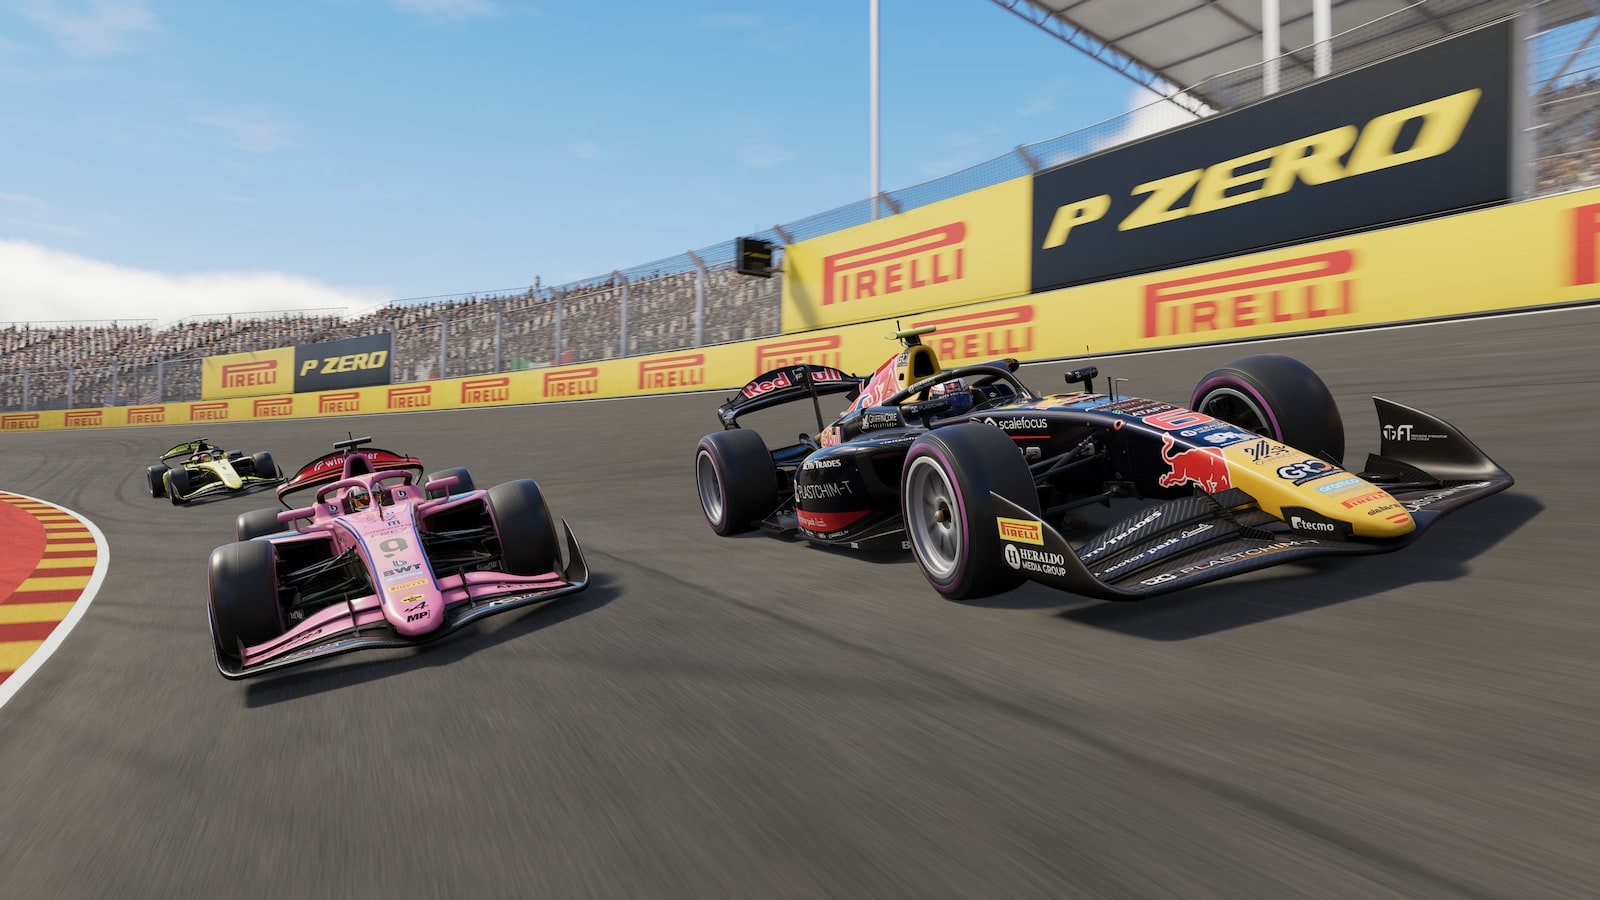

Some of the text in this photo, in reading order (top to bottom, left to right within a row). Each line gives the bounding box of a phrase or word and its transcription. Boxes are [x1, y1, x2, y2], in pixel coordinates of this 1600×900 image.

[1042, 88, 1483, 250] P ZERO
[823, 220, 967, 306] PIRELLI
[1142, 249, 1358, 338] PIRELLI
[222, 359, 278, 388] PIRELLI
[299, 350, 389, 377] P ZERO
[638, 353, 705, 390] PIRELLI
[460, 377, 510, 404] PIRELLI
[543, 367, 599, 398] PIRELLI
[741, 371, 793, 400] Red
[253, 397, 294, 417] PIRELLI
[318, 391, 361, 414] PIRELLI
[387, 385, 432, 409] PIRELLI
[1, 413, 40, 430] PIRELLI
[64, 410, 103, 427] PIRELLI
[127, 406, 166, 424] PIRELLI
[189, 402, 229, 421] PIRELLI
[1142, 408, 1215, 431] 6
[998, 416, 1048, 430] scalefocus
[1000, 521, 1040, 541] PIRELLI
[1301, 519, 1335, 532] tecmo
[379, 537, 409, 559] 9
[1146, 536, 1180, 555] park
[1019, 548, 1065, 567] HERALDO
[1021, 559, 1067, 577] MEDIA GROUP
